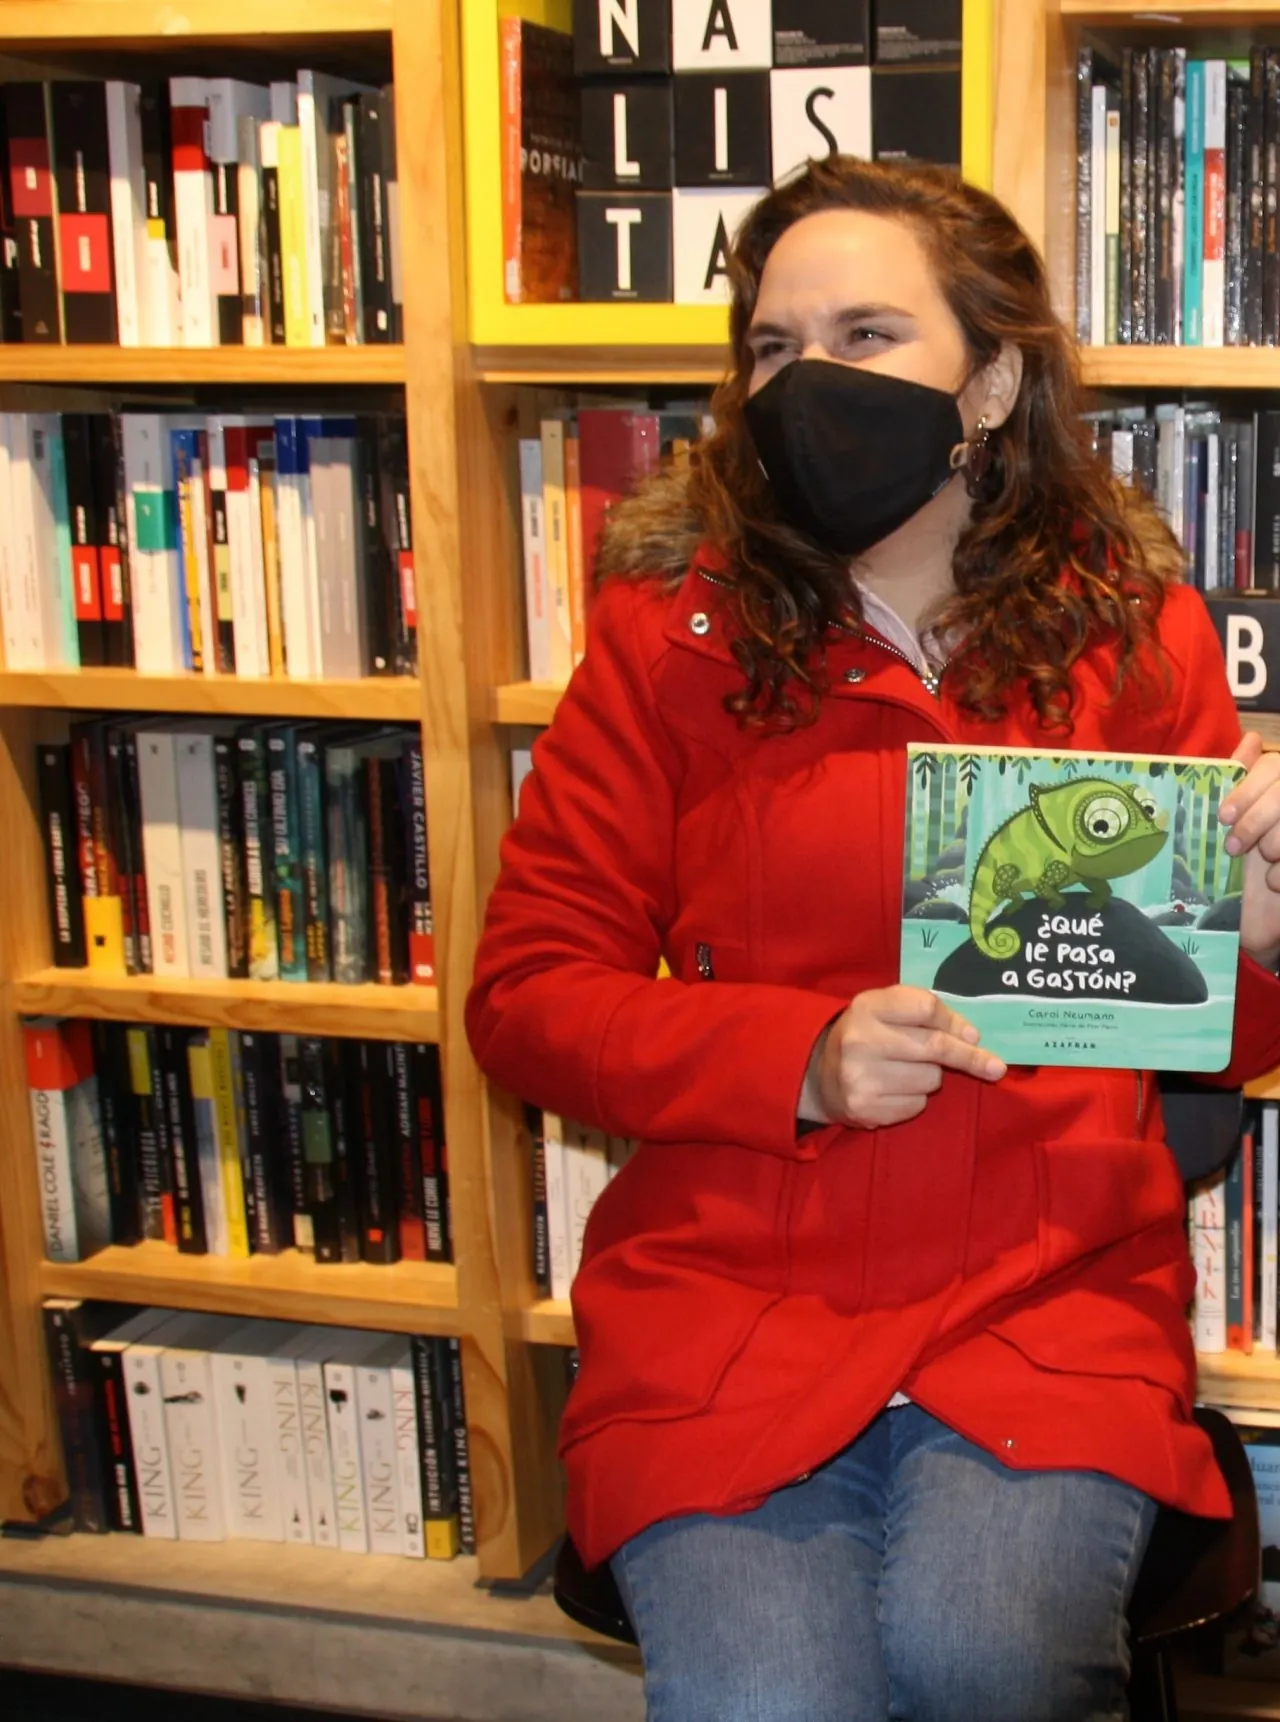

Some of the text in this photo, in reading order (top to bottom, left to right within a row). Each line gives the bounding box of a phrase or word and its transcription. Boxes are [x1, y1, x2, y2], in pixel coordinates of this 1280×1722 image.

[411, 750, 428, 889] JAVIER CASTILLO
[1025, 941, 1052, 963] le
[1036, 912, 1105, 940] ¿Qué
[1002, 969, 1019, 989] a
[1028, 1009, 1115, 1022] Carol Neumann
[274, 1380, 298, 1453] KING
[302, 1381, 325, 1453] KING
[393, 1389, 415, 1452] KING
[140, 1446, 168, 1519] KING
[178, 1449, 209, 1521] KING
[237, 1446, 264, 1519] KING
[336, 1461, 360, 1533] KING
[369, 1461, 396, 1535] KING
[454, 1427, 475, 1544] STEPHEN KING
